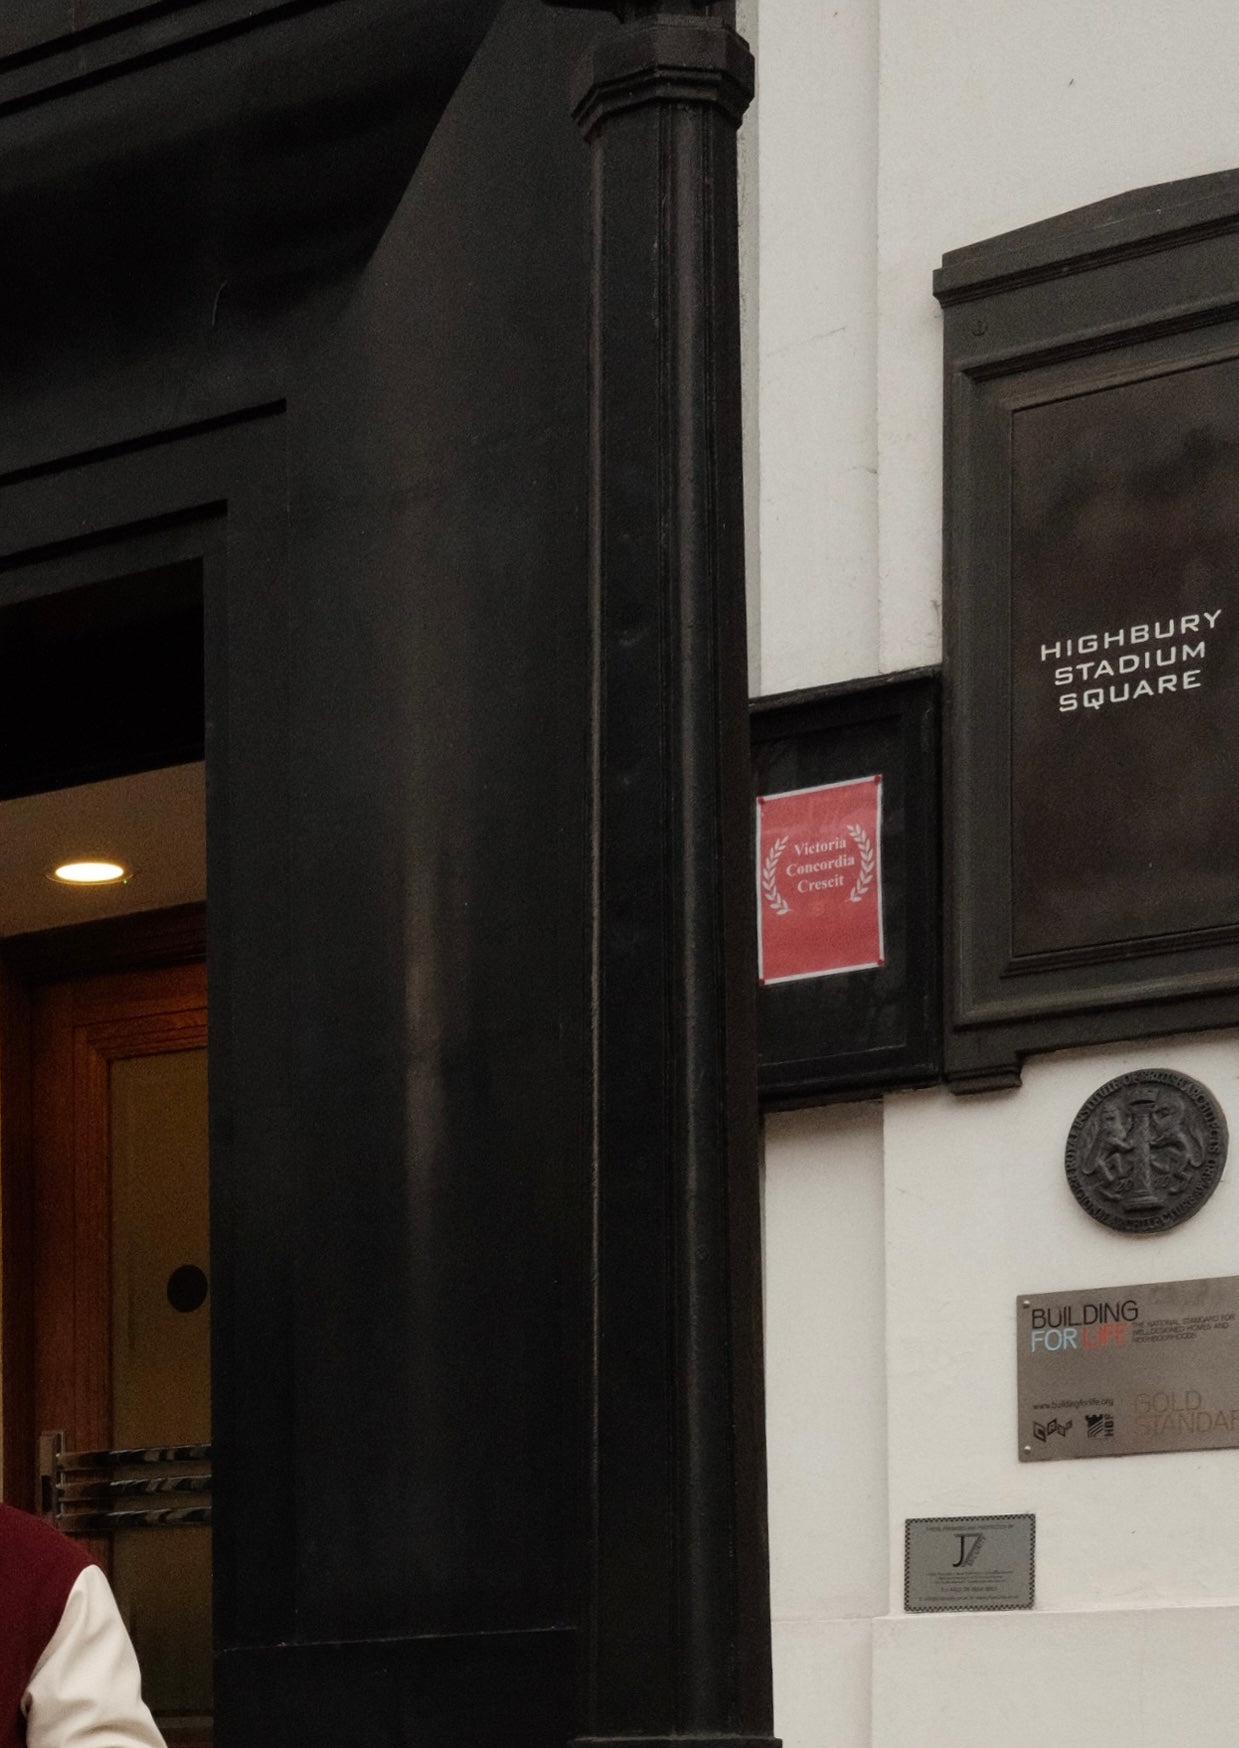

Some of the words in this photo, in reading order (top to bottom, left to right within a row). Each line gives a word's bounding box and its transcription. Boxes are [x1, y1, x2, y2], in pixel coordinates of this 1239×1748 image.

[1041, 609, 1222, 661] HIGHBURY
[1054, 641, 1206, 686] STADIUM
[1059, 669, 1202, 712] SQUARE
[794, 837, 847, 856] Victoria
[786, 854, 855, 877] Concordia
[797, 874, 845, 893] Crescit
[1031, 1300, 1139, 1330] BUILDING
[1031, 1328, 1078, 1352] FOR
[1082, 1322, 1129, 1349] LIFE
[1134, 1390, 1202, 1413] GOLD
